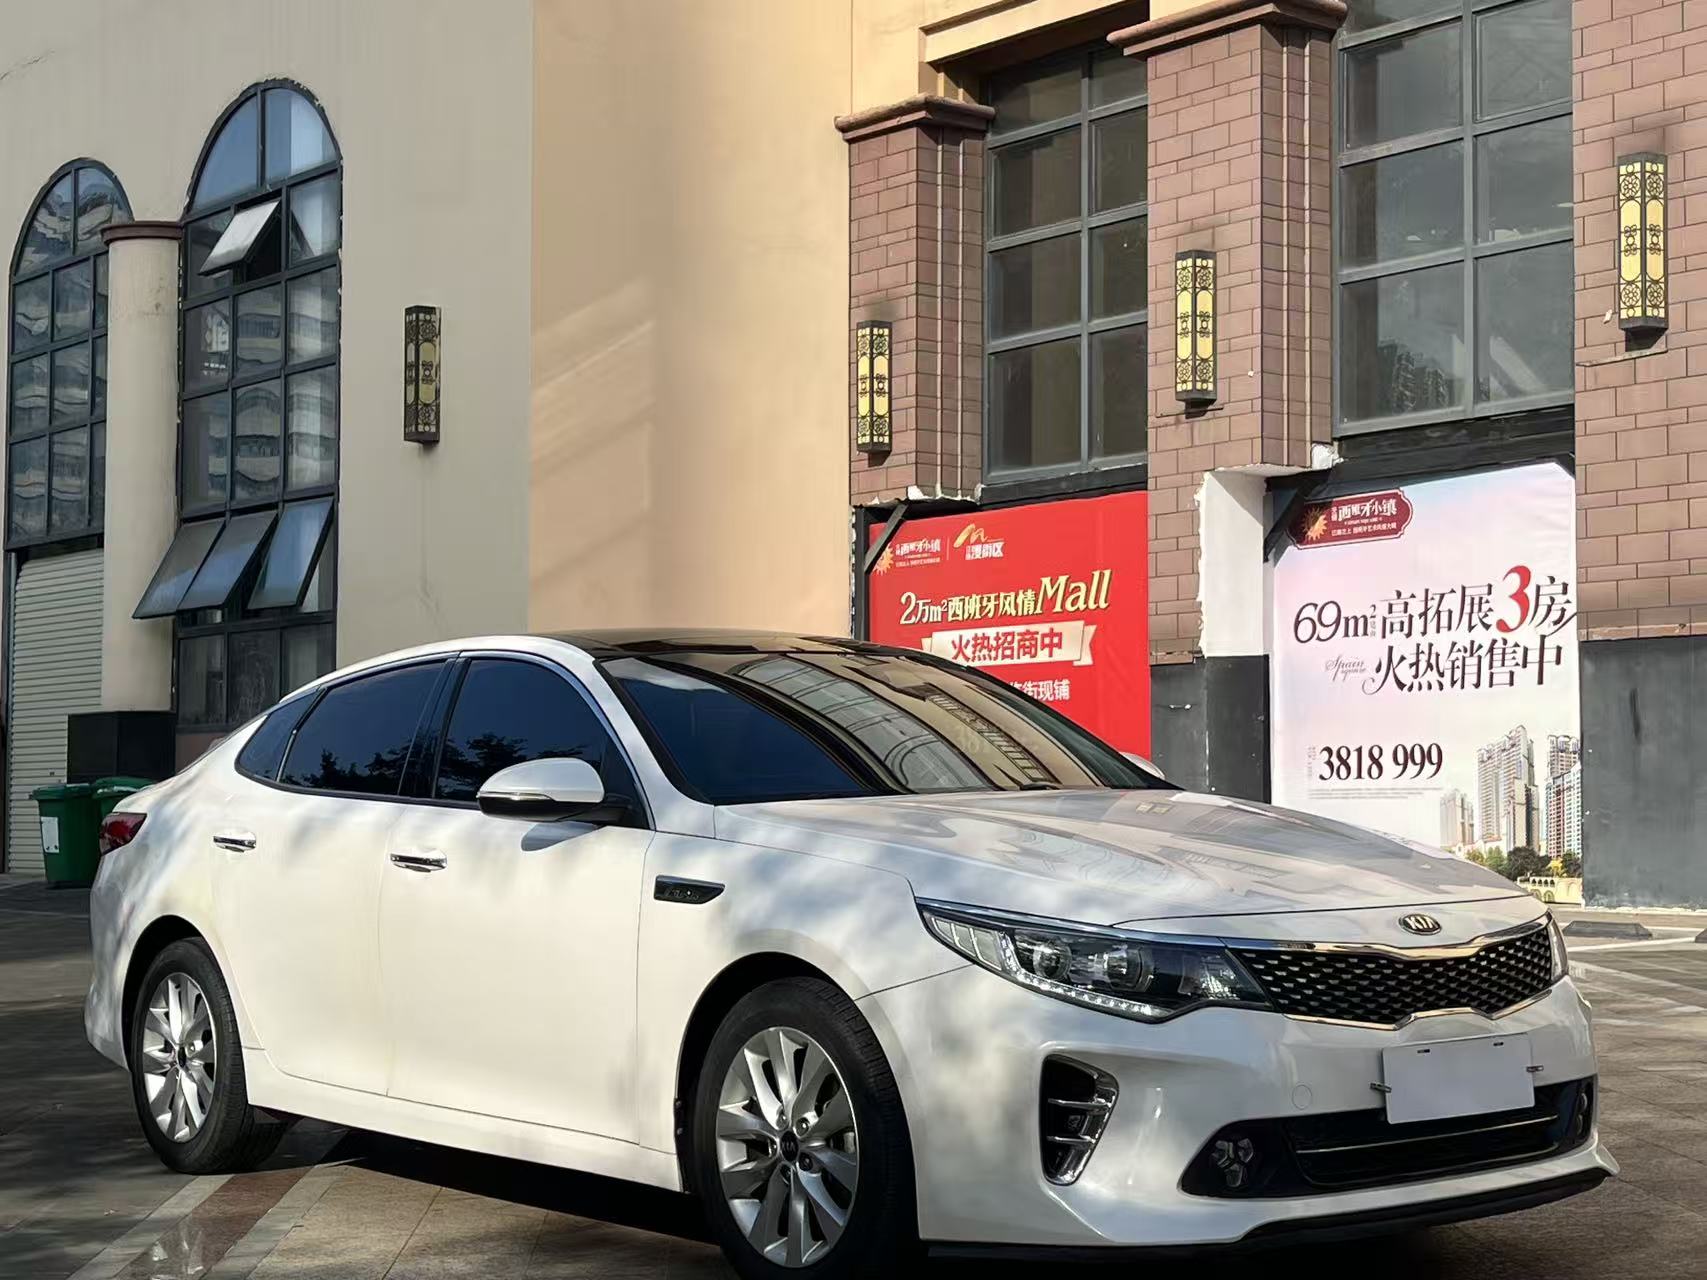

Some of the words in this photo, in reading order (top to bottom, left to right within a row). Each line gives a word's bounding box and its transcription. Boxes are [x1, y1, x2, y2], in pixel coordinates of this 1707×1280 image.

[951, 627, 1063, 663] 火热招商中
[1362, 634, 1563, 695] 火热销售中
[1319, 745, 1384, 781] 3818
[1392, 743, 1443, 780] 999
[1404, 915, 1440, 931] KIA
